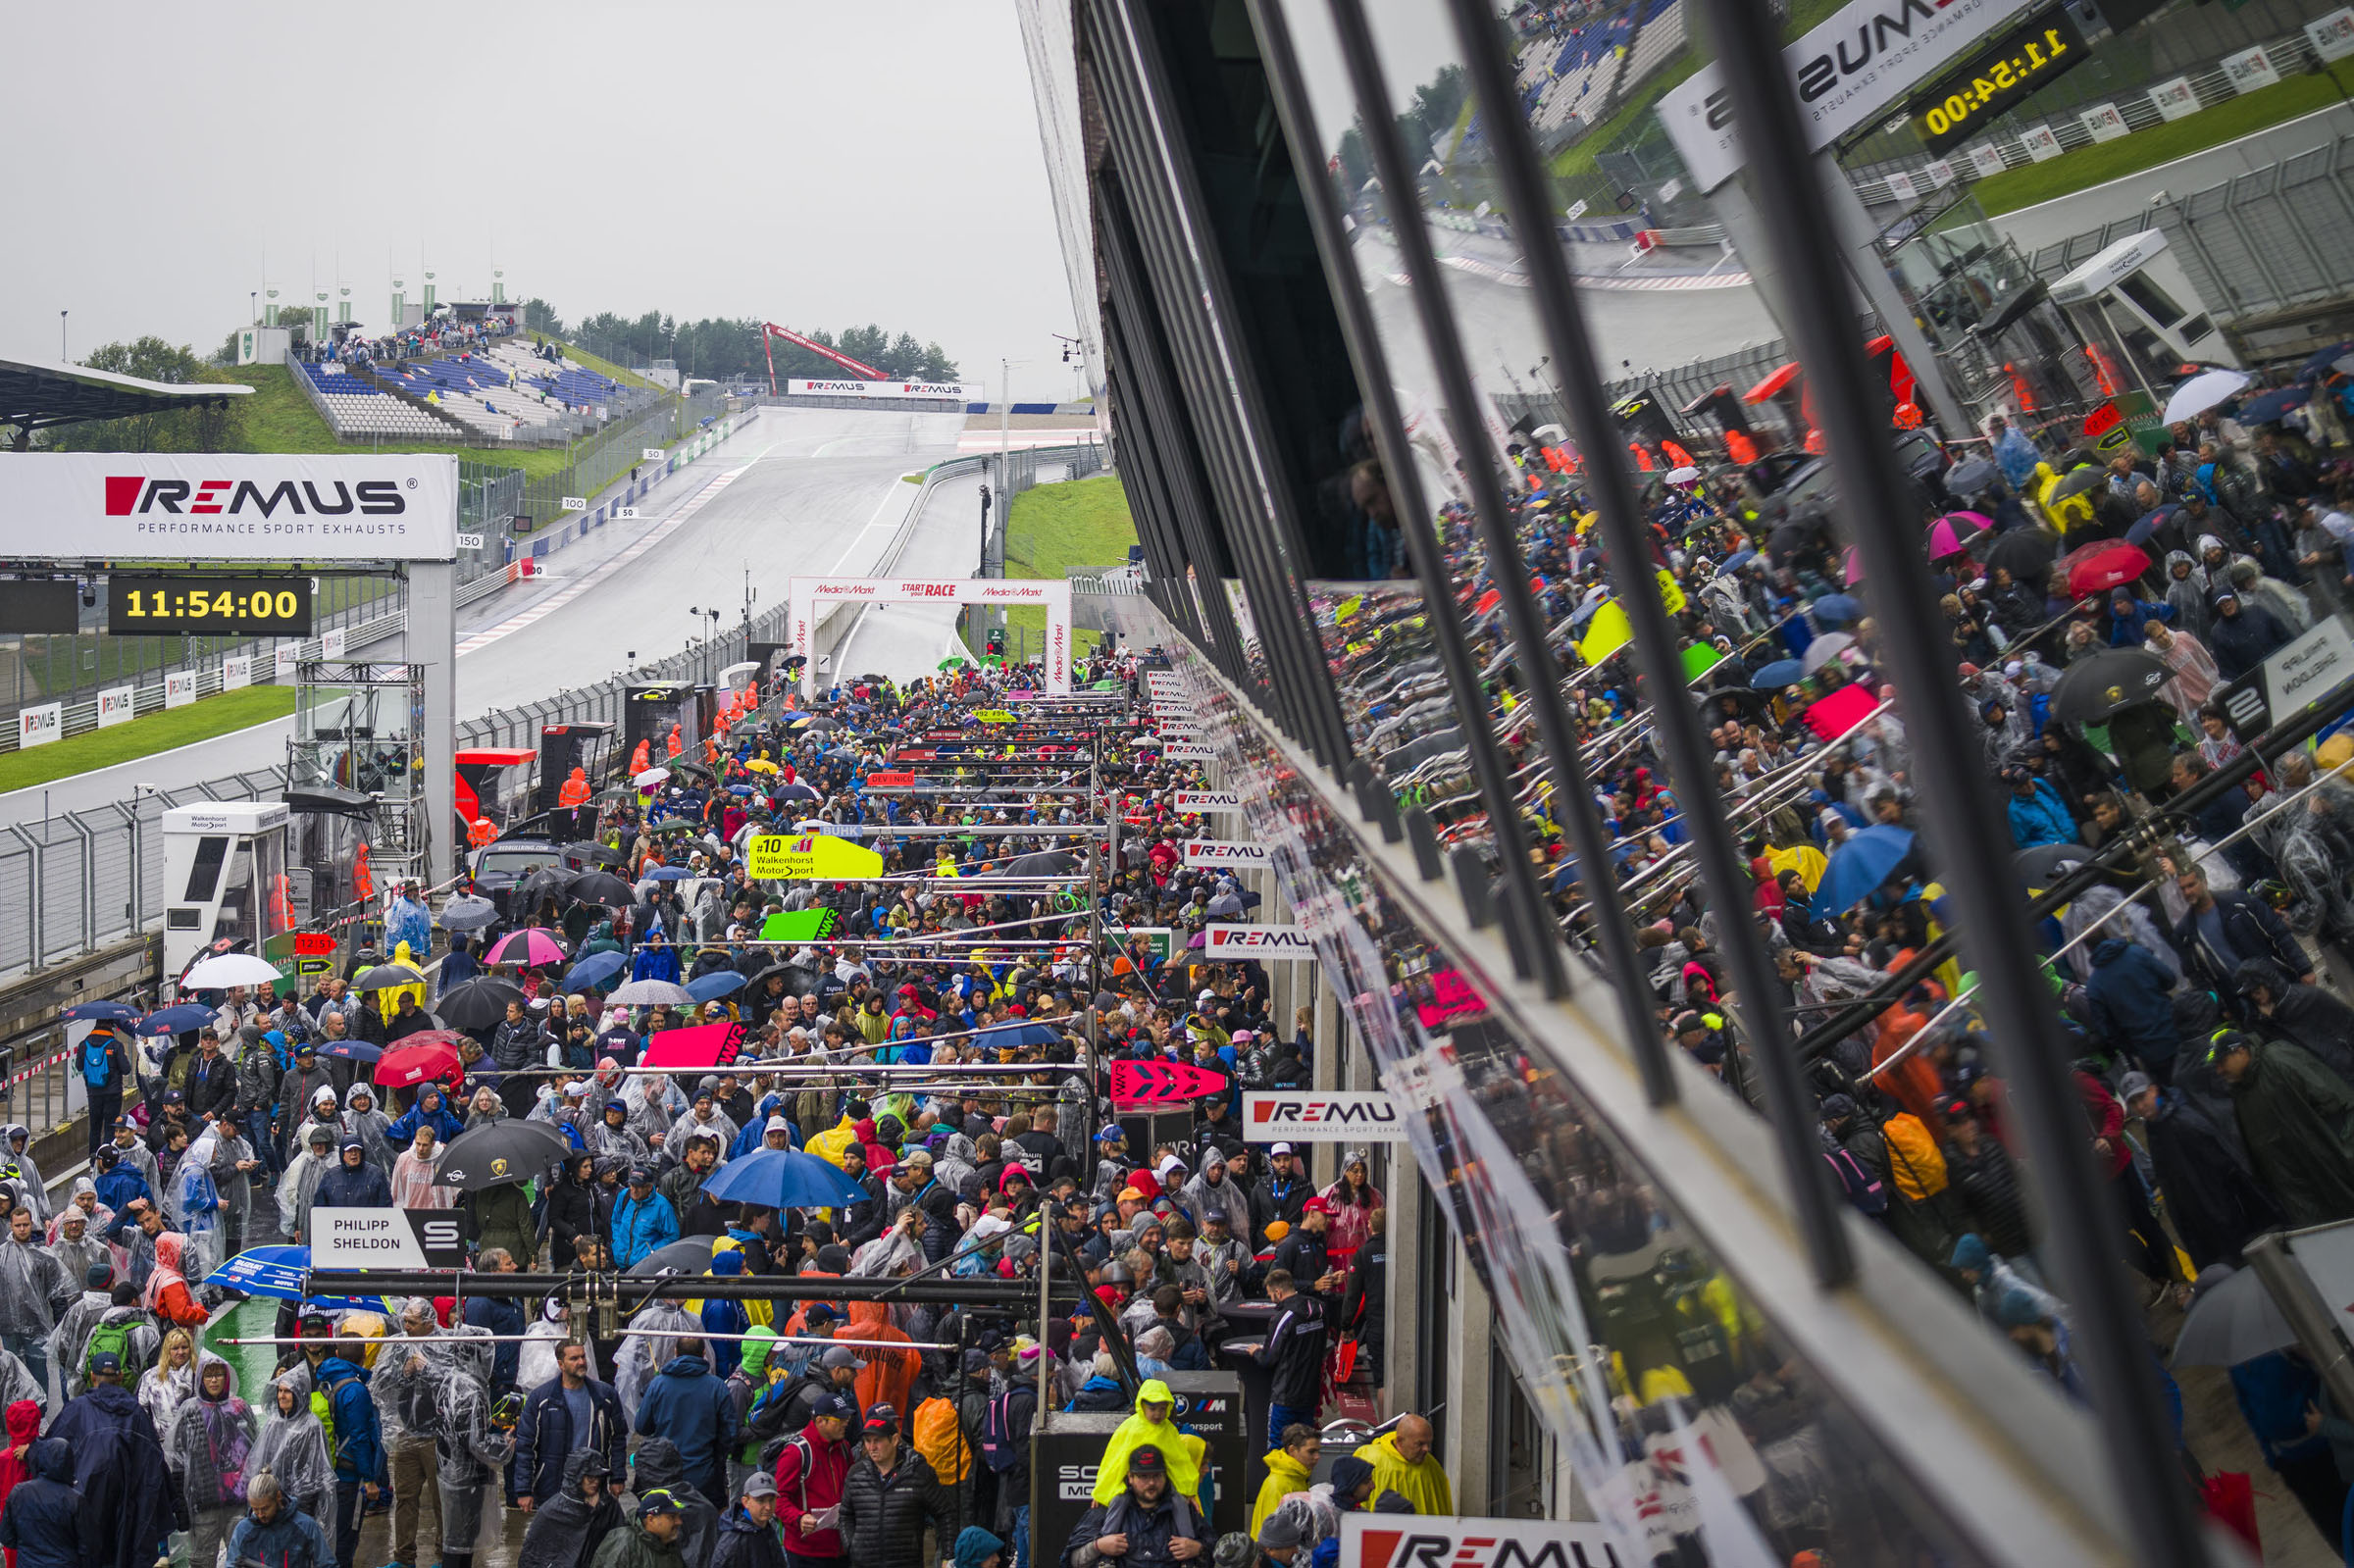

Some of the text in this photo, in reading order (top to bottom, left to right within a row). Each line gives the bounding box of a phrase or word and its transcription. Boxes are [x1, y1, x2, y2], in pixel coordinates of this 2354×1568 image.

[813, 382, 865, 391] REMUS
[910, 384, 962, 394] REMUS
[138, 480, 406, 519] REMUS
[565, 499, 584, 509] 100
[137, 523, 406, 534] PERFORMANCE SPORT EXHAUSTS
[459, 535, 480, 547] 150
[901, 583, 925, 592] START
[925, 584, 956, 597] RACE
[127, 590, 298, 619] 11:54:00
[106, 693, 128, 712] REMUS
[28, 711, 56, 732] REMUS
[1173, 745, 1214, 754] REMU
[1187, 794, 1239, 804] REMU
[824, 826, 858, 835] BUHK
[756, 838, 782, 853] #10
[1200, 845, 1264, 858] REMU
[756, 856, 814, 865] Walkenhorst
[1226, 932, 1310, 947] REMU
[1272, 1101, 1397, 1125] REMU
[334, 1219, 389, 1231] PHILIPP
[333, 1238, 400, 1249] SHELDON
[1394, 1534, 1623, 1568] REMU
